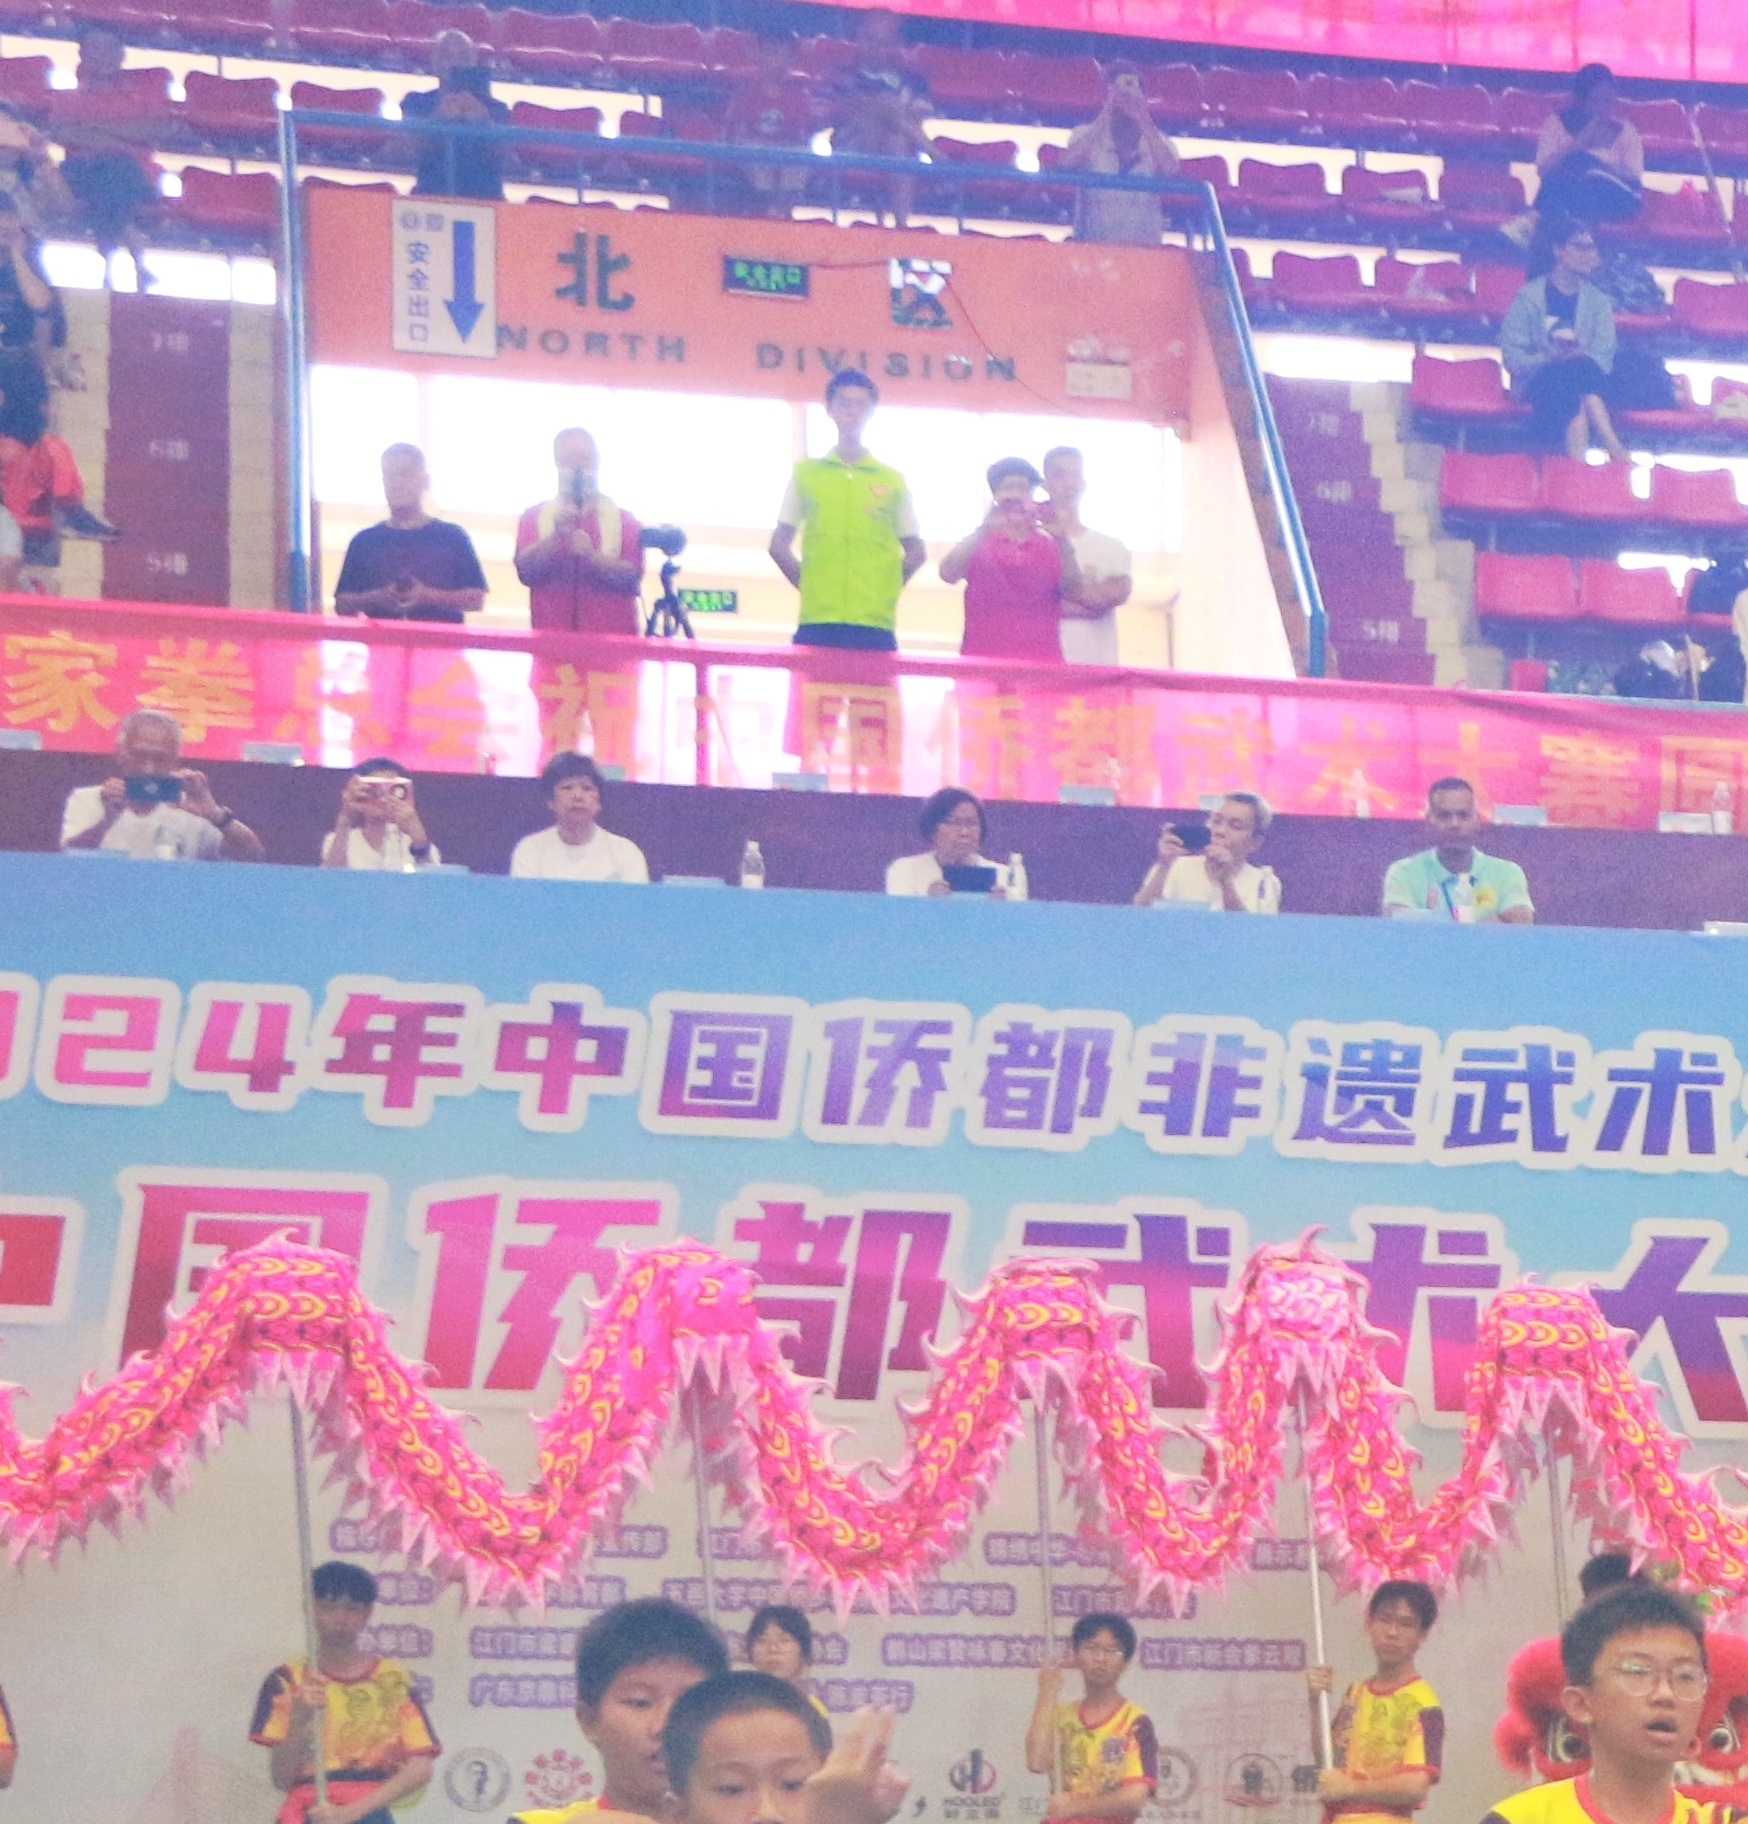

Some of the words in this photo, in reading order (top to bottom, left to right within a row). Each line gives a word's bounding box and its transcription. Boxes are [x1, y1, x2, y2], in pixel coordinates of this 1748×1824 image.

[554, 231, 635, 312] 北
[497, 323, 687, 363] NORTH
[756, 341, 1017, 381] DIVISION
